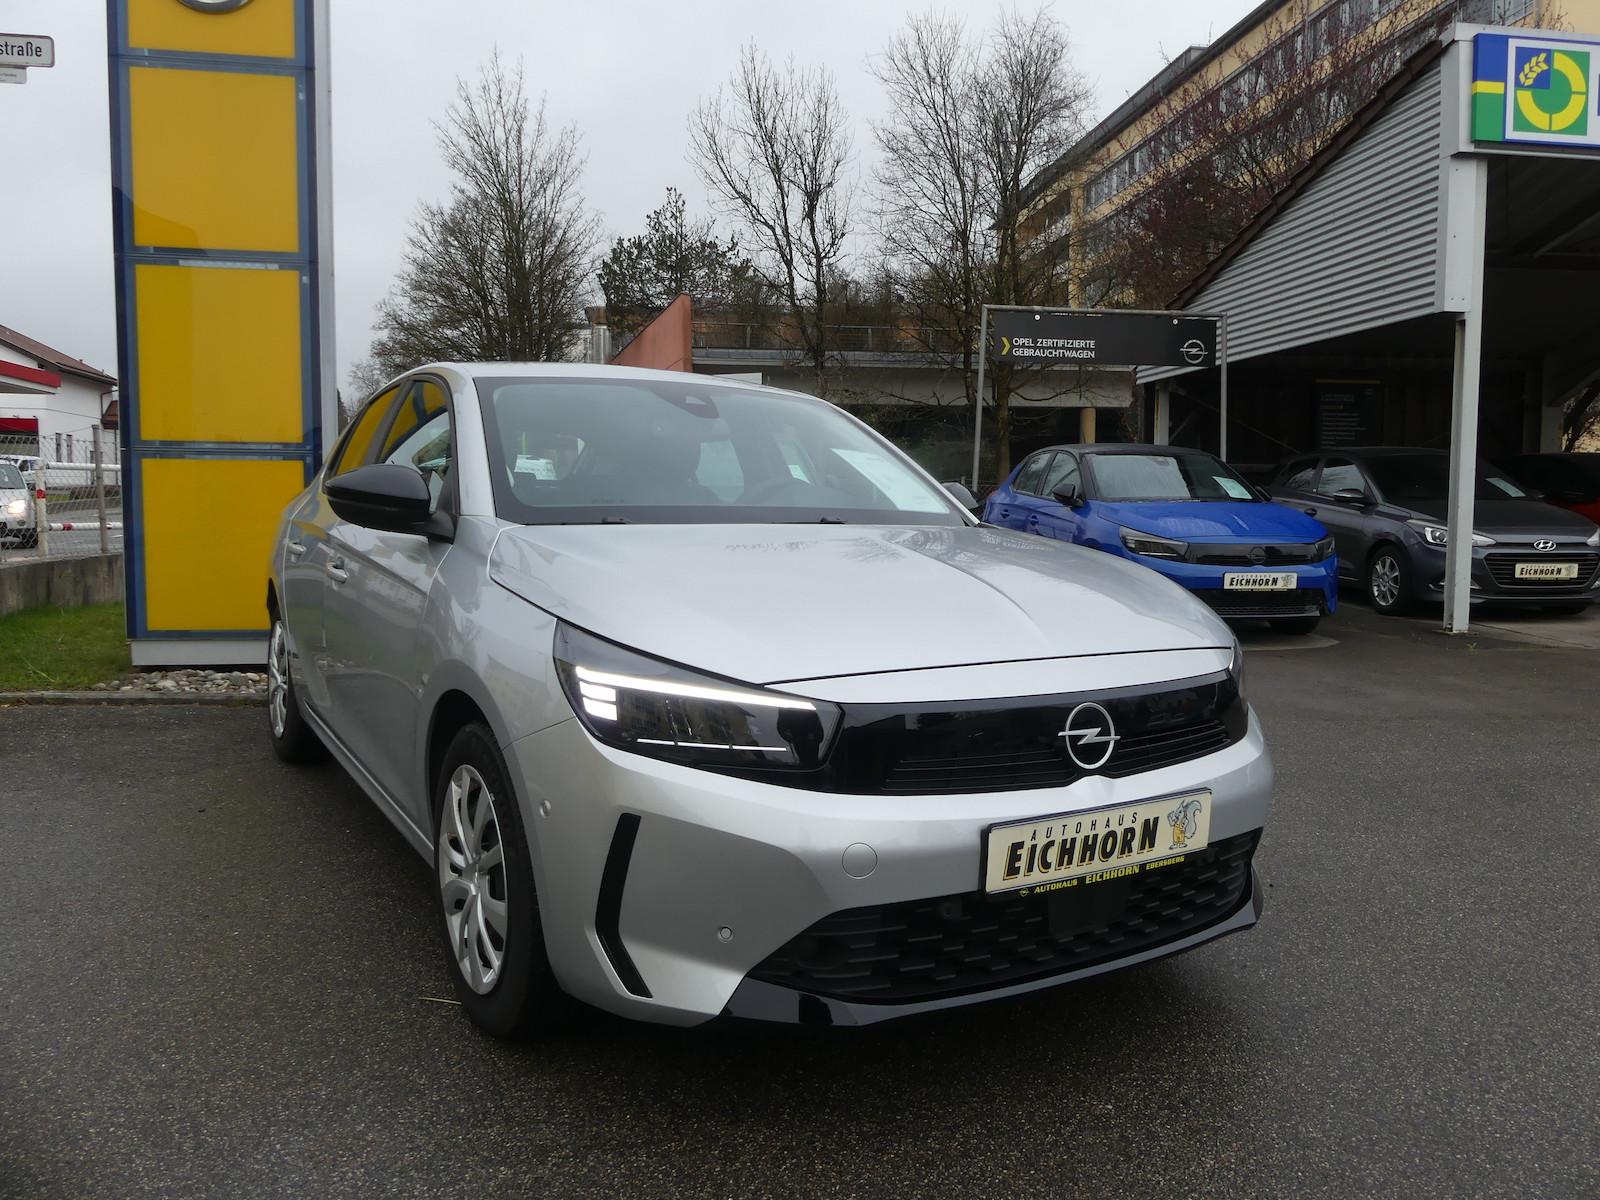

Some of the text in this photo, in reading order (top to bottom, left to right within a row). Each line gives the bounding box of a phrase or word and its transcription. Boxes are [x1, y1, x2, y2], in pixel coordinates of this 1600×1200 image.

[1012, 337, 1096, 348] OPEL ZERTIFIZIERTE
[1012, 347, 1095, 358] GEBRAUCHTWAGEN
[1519, 567, 1562, 576] EICHHORN
[1229, 577, 1279, 587] EICHHORN
[1030, 812, 1138, 841] AUTOHAUS
[1002, 816, 1160, 881] EICHHORN
[1033, 856, 1185, 894] AUTOHAUS EICHHORN EBERSBERG
